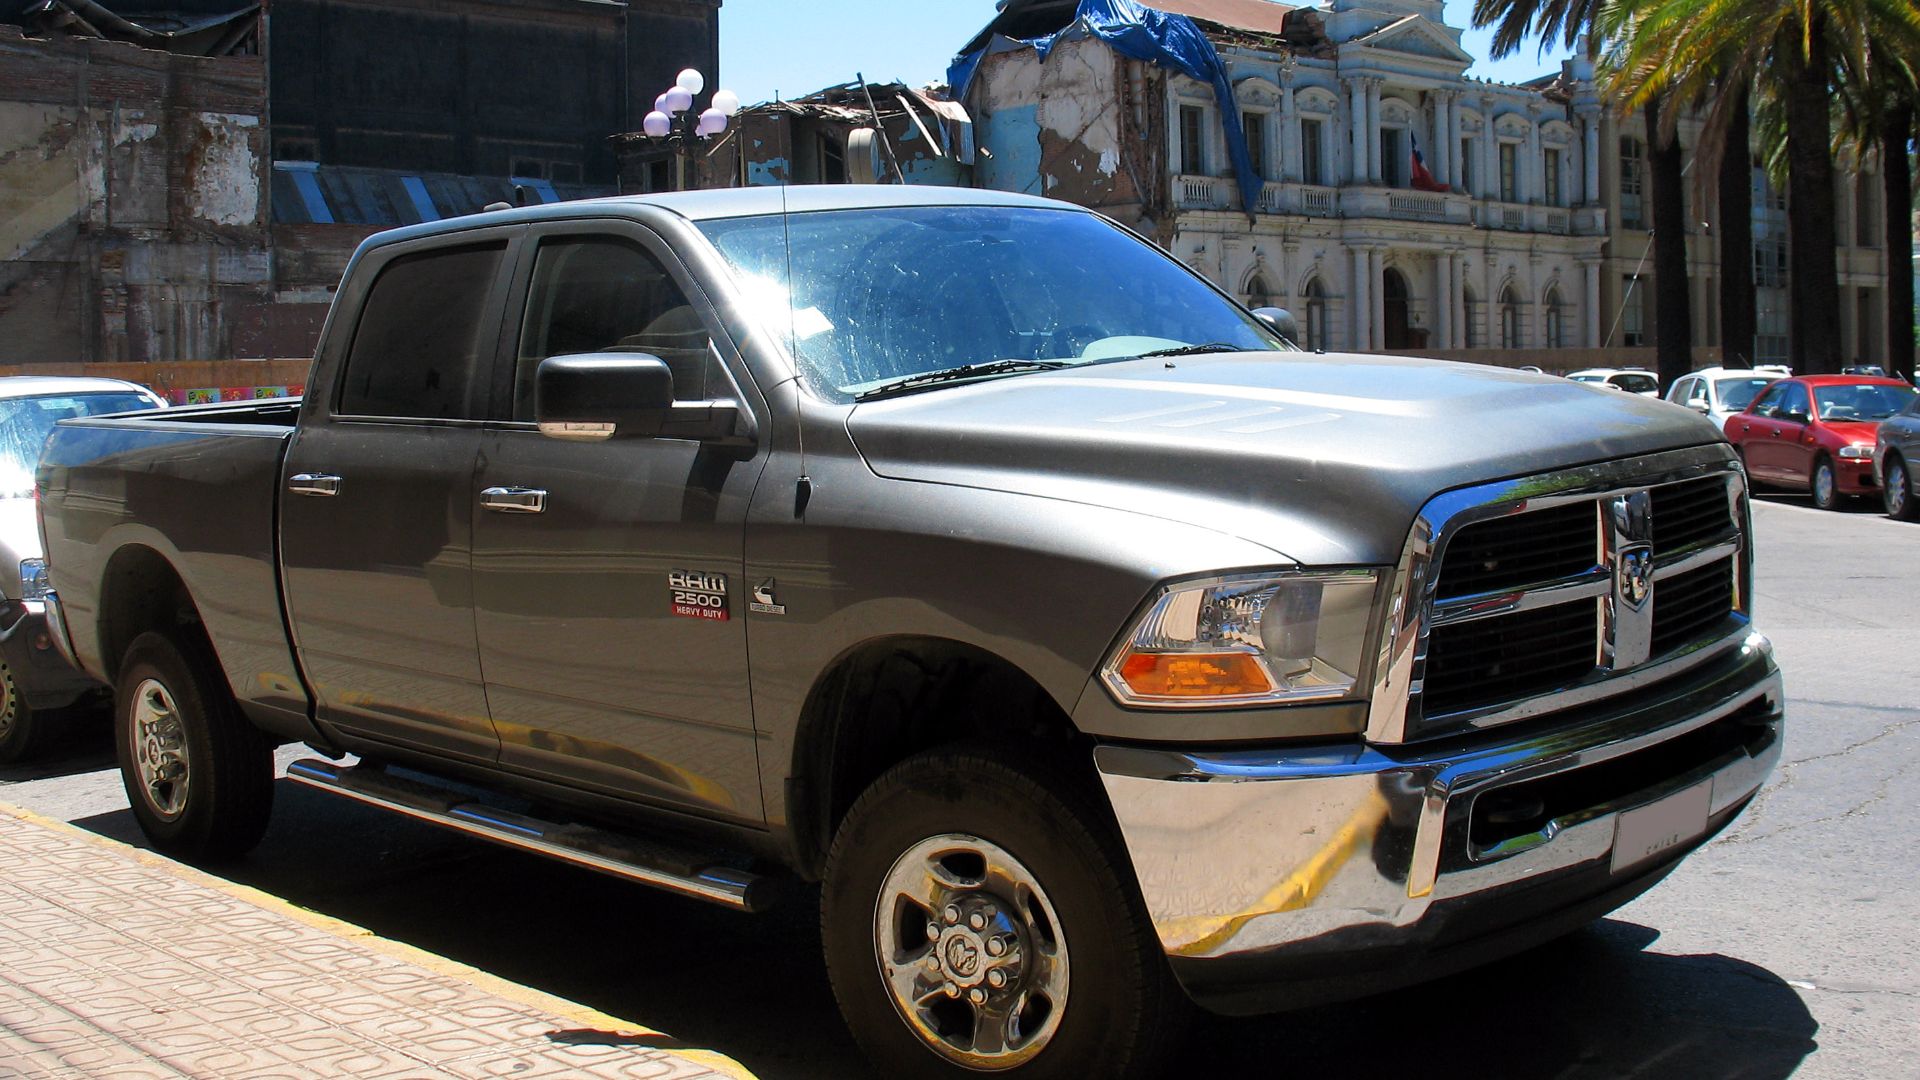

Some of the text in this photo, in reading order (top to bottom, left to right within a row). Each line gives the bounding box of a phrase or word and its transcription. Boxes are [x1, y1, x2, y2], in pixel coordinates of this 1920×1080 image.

[668, 570, 726, 592] RAM
[674, 592, 722, 607] 2500
[676, 606, 722, 618] HEAVY DUTY
